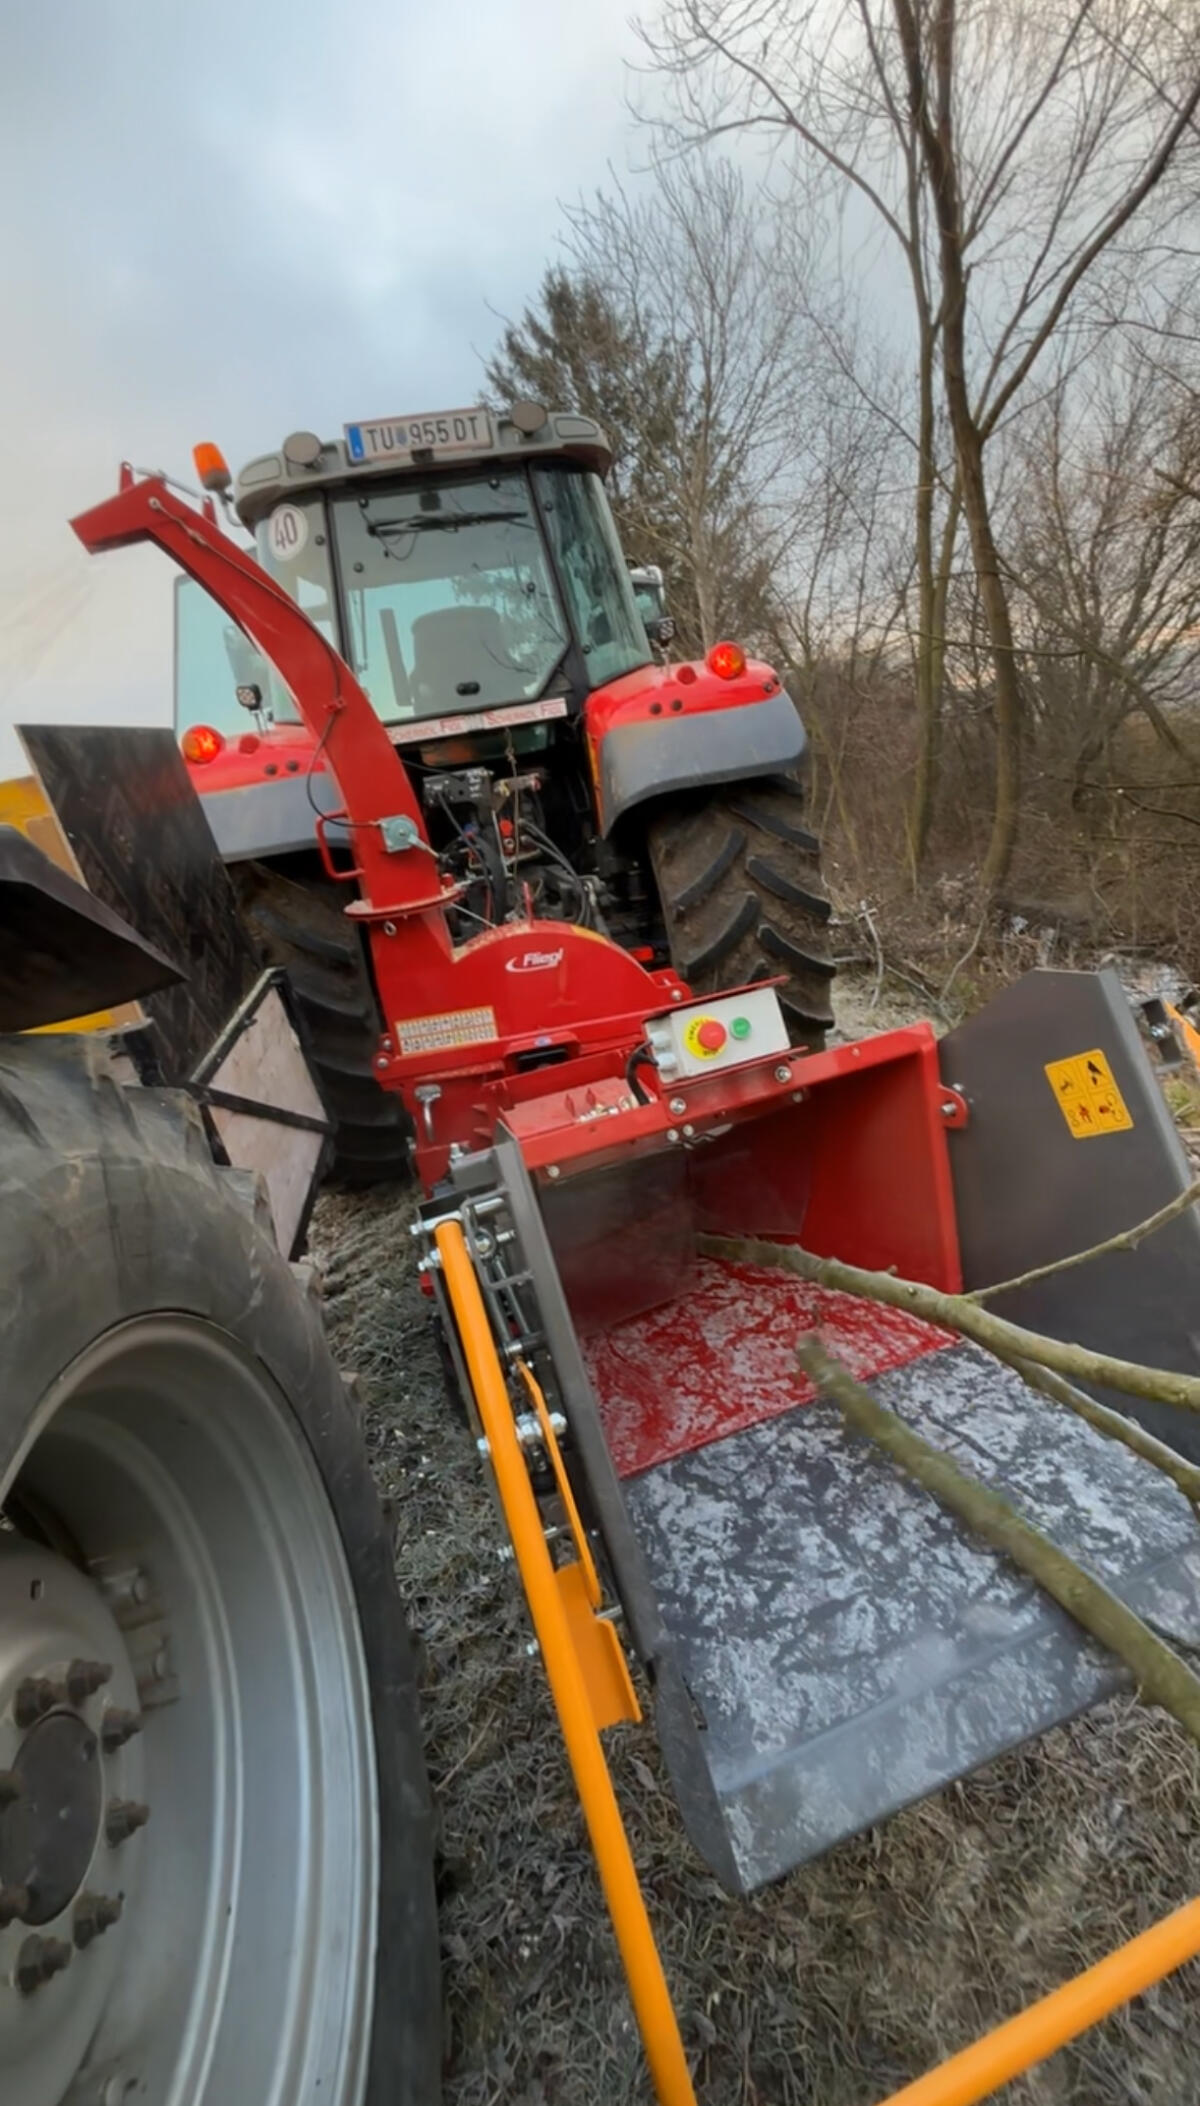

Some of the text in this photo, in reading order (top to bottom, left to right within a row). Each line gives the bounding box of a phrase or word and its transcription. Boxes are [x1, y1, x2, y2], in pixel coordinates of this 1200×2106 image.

[367, 416, 478, 452] TU 955 DT
[274, 511, 298, 549] 40
